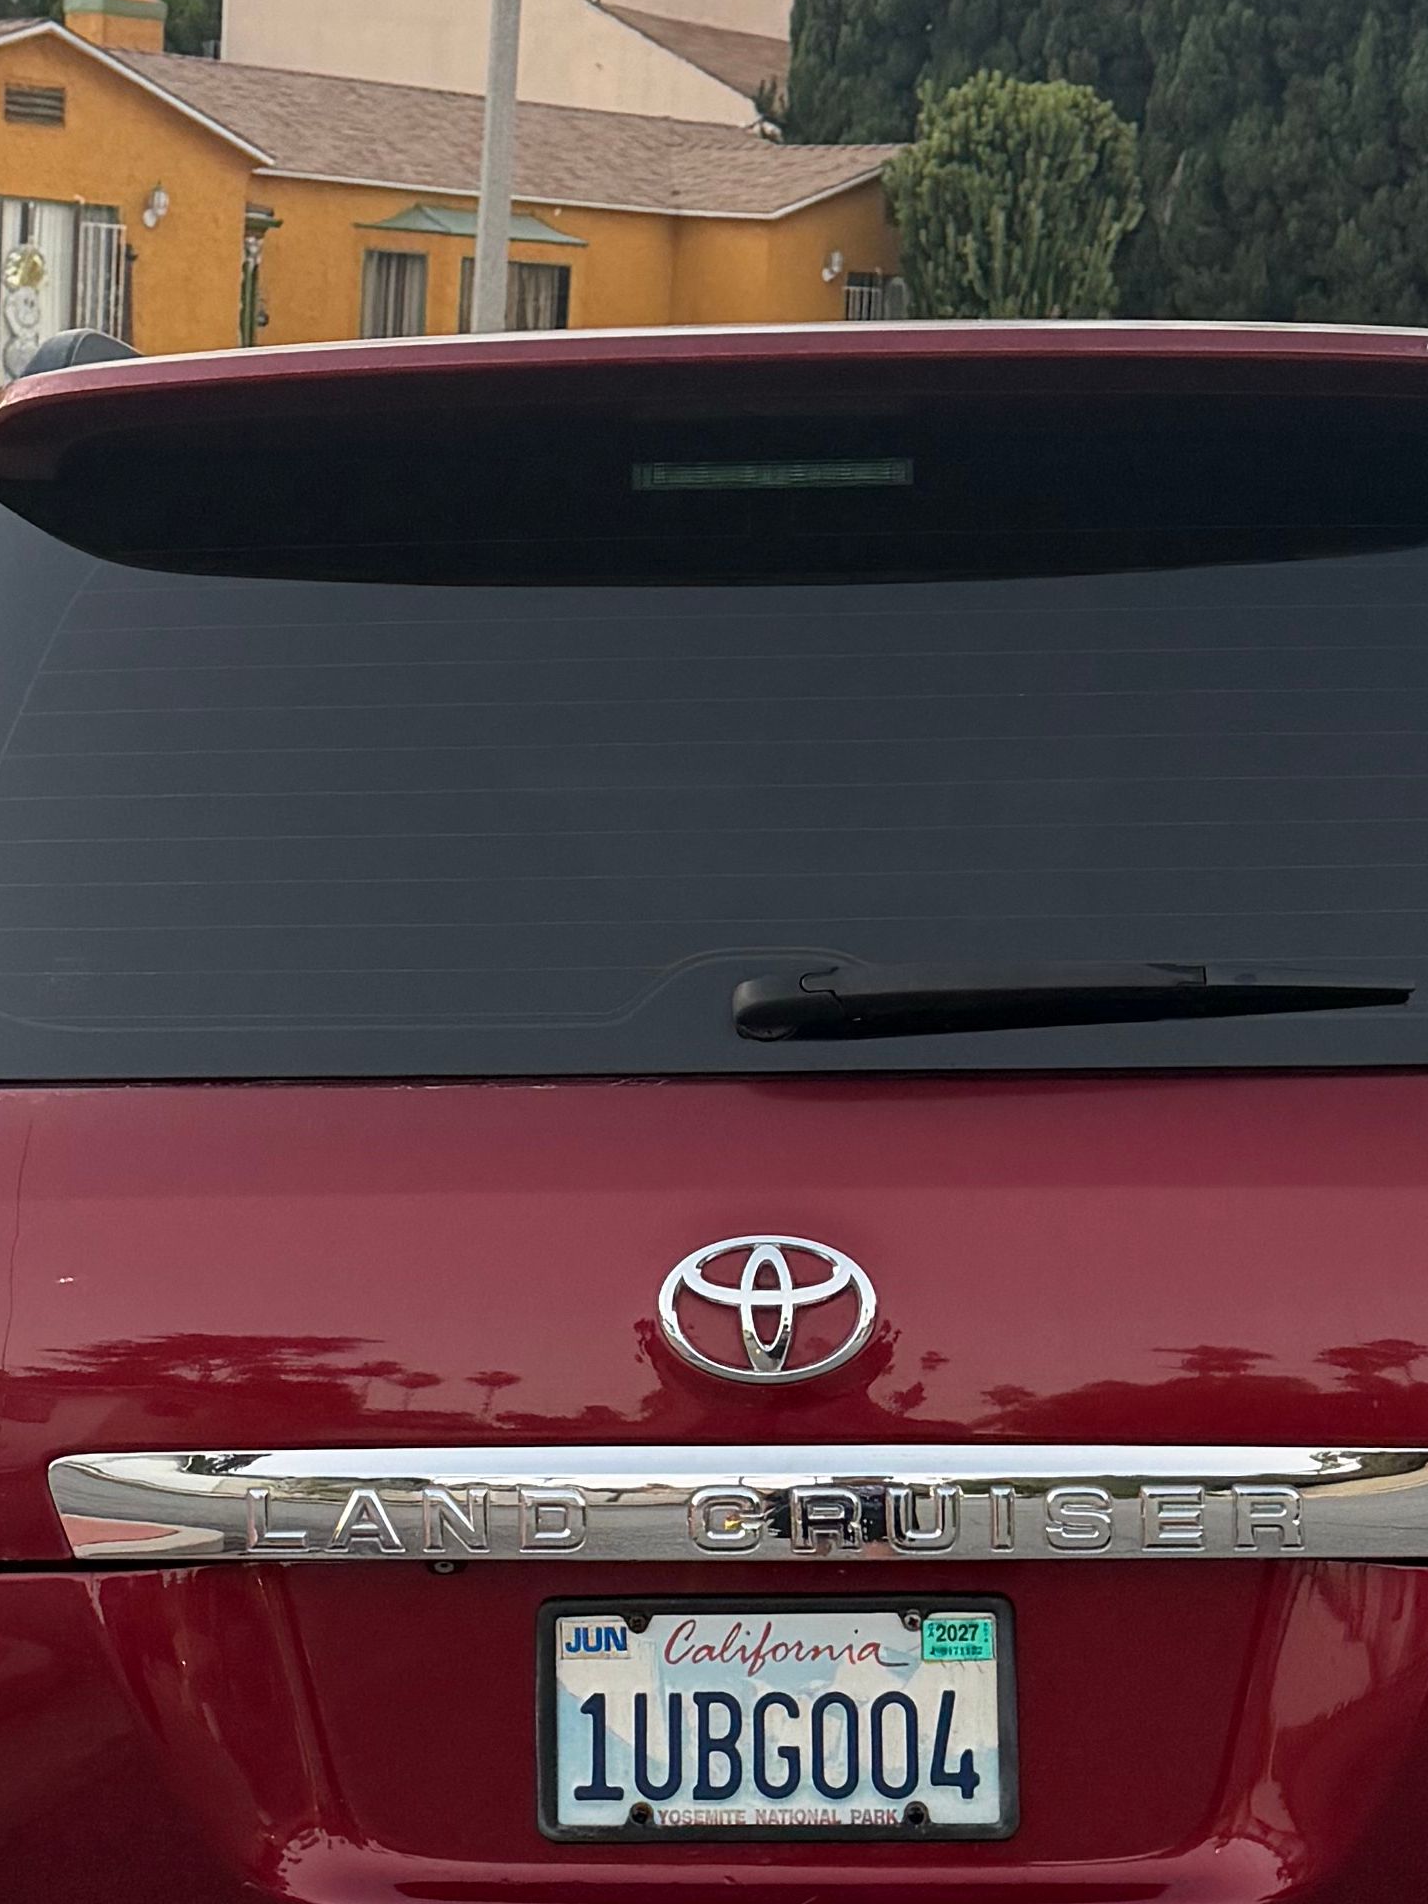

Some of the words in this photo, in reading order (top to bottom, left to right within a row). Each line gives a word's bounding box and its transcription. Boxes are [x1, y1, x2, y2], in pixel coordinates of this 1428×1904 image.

[246, 1486, 587, 1553] LAND
[687, 1484, 1305, 1554] CRUISER
[565, 1626, 628, 1652] JUN
[664, 1619, 909, 1677] California
[935, 1623, 980, 1642] 2027
[573, 1690, 981, 1802] 1UBG004
[658, 1809, 746, 1825] YOSEMITE
[756, 1809, 842, 1825] NATIONAL
[851, 1809, 900, 1825] PARK
